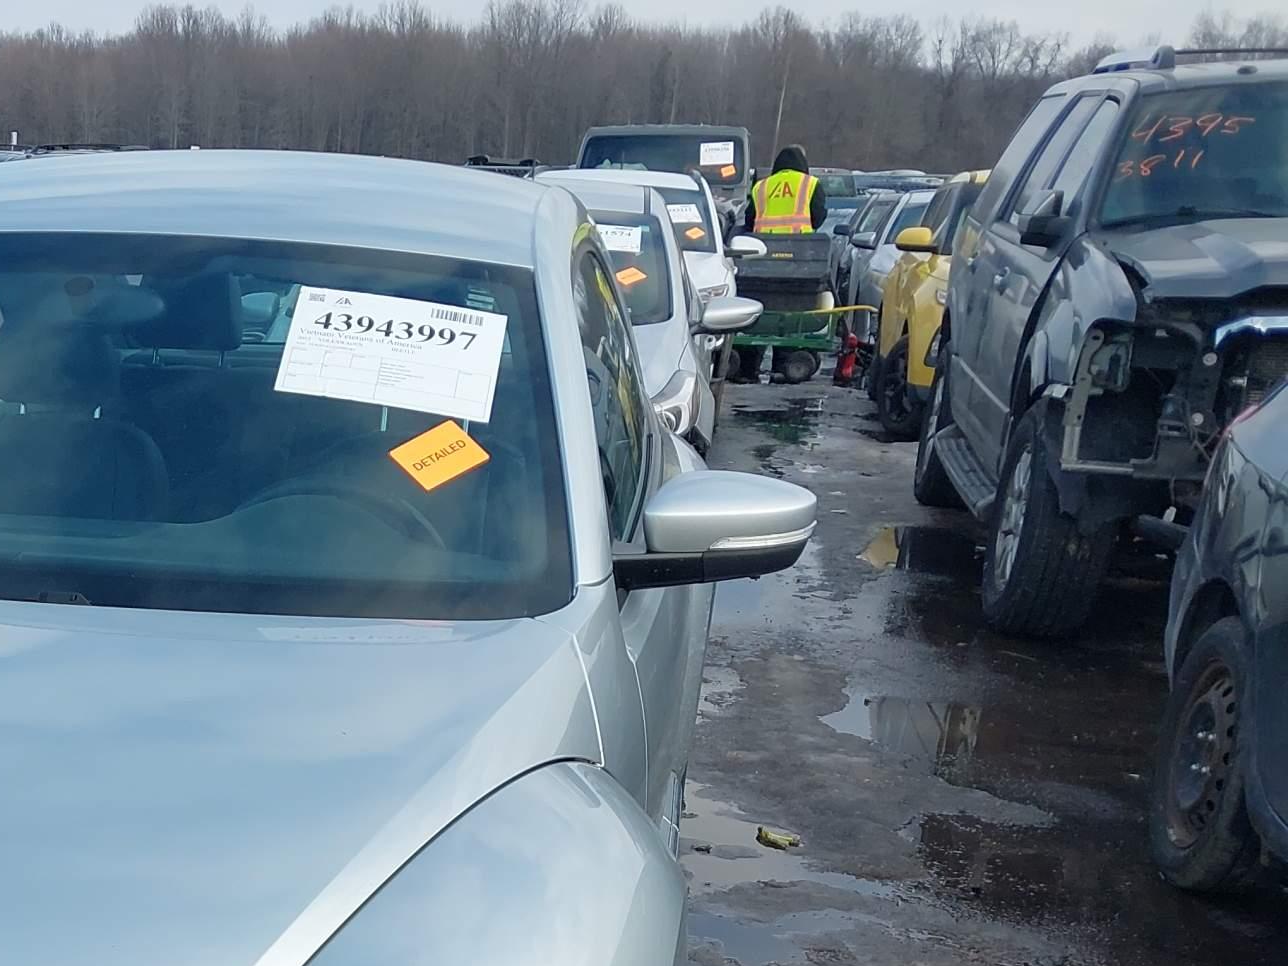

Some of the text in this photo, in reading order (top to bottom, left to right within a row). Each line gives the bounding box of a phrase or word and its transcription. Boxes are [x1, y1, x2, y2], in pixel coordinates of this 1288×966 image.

[1131, 112, 1256, 144] 4395
[300, 327, 334, 337] Vietnam
[337, 332, 374, 343] Veterans
[386, 340, 423, 350] America
[314, 311, 478, 350] 43943997
[412, 439, 467, 471] DETAILED
